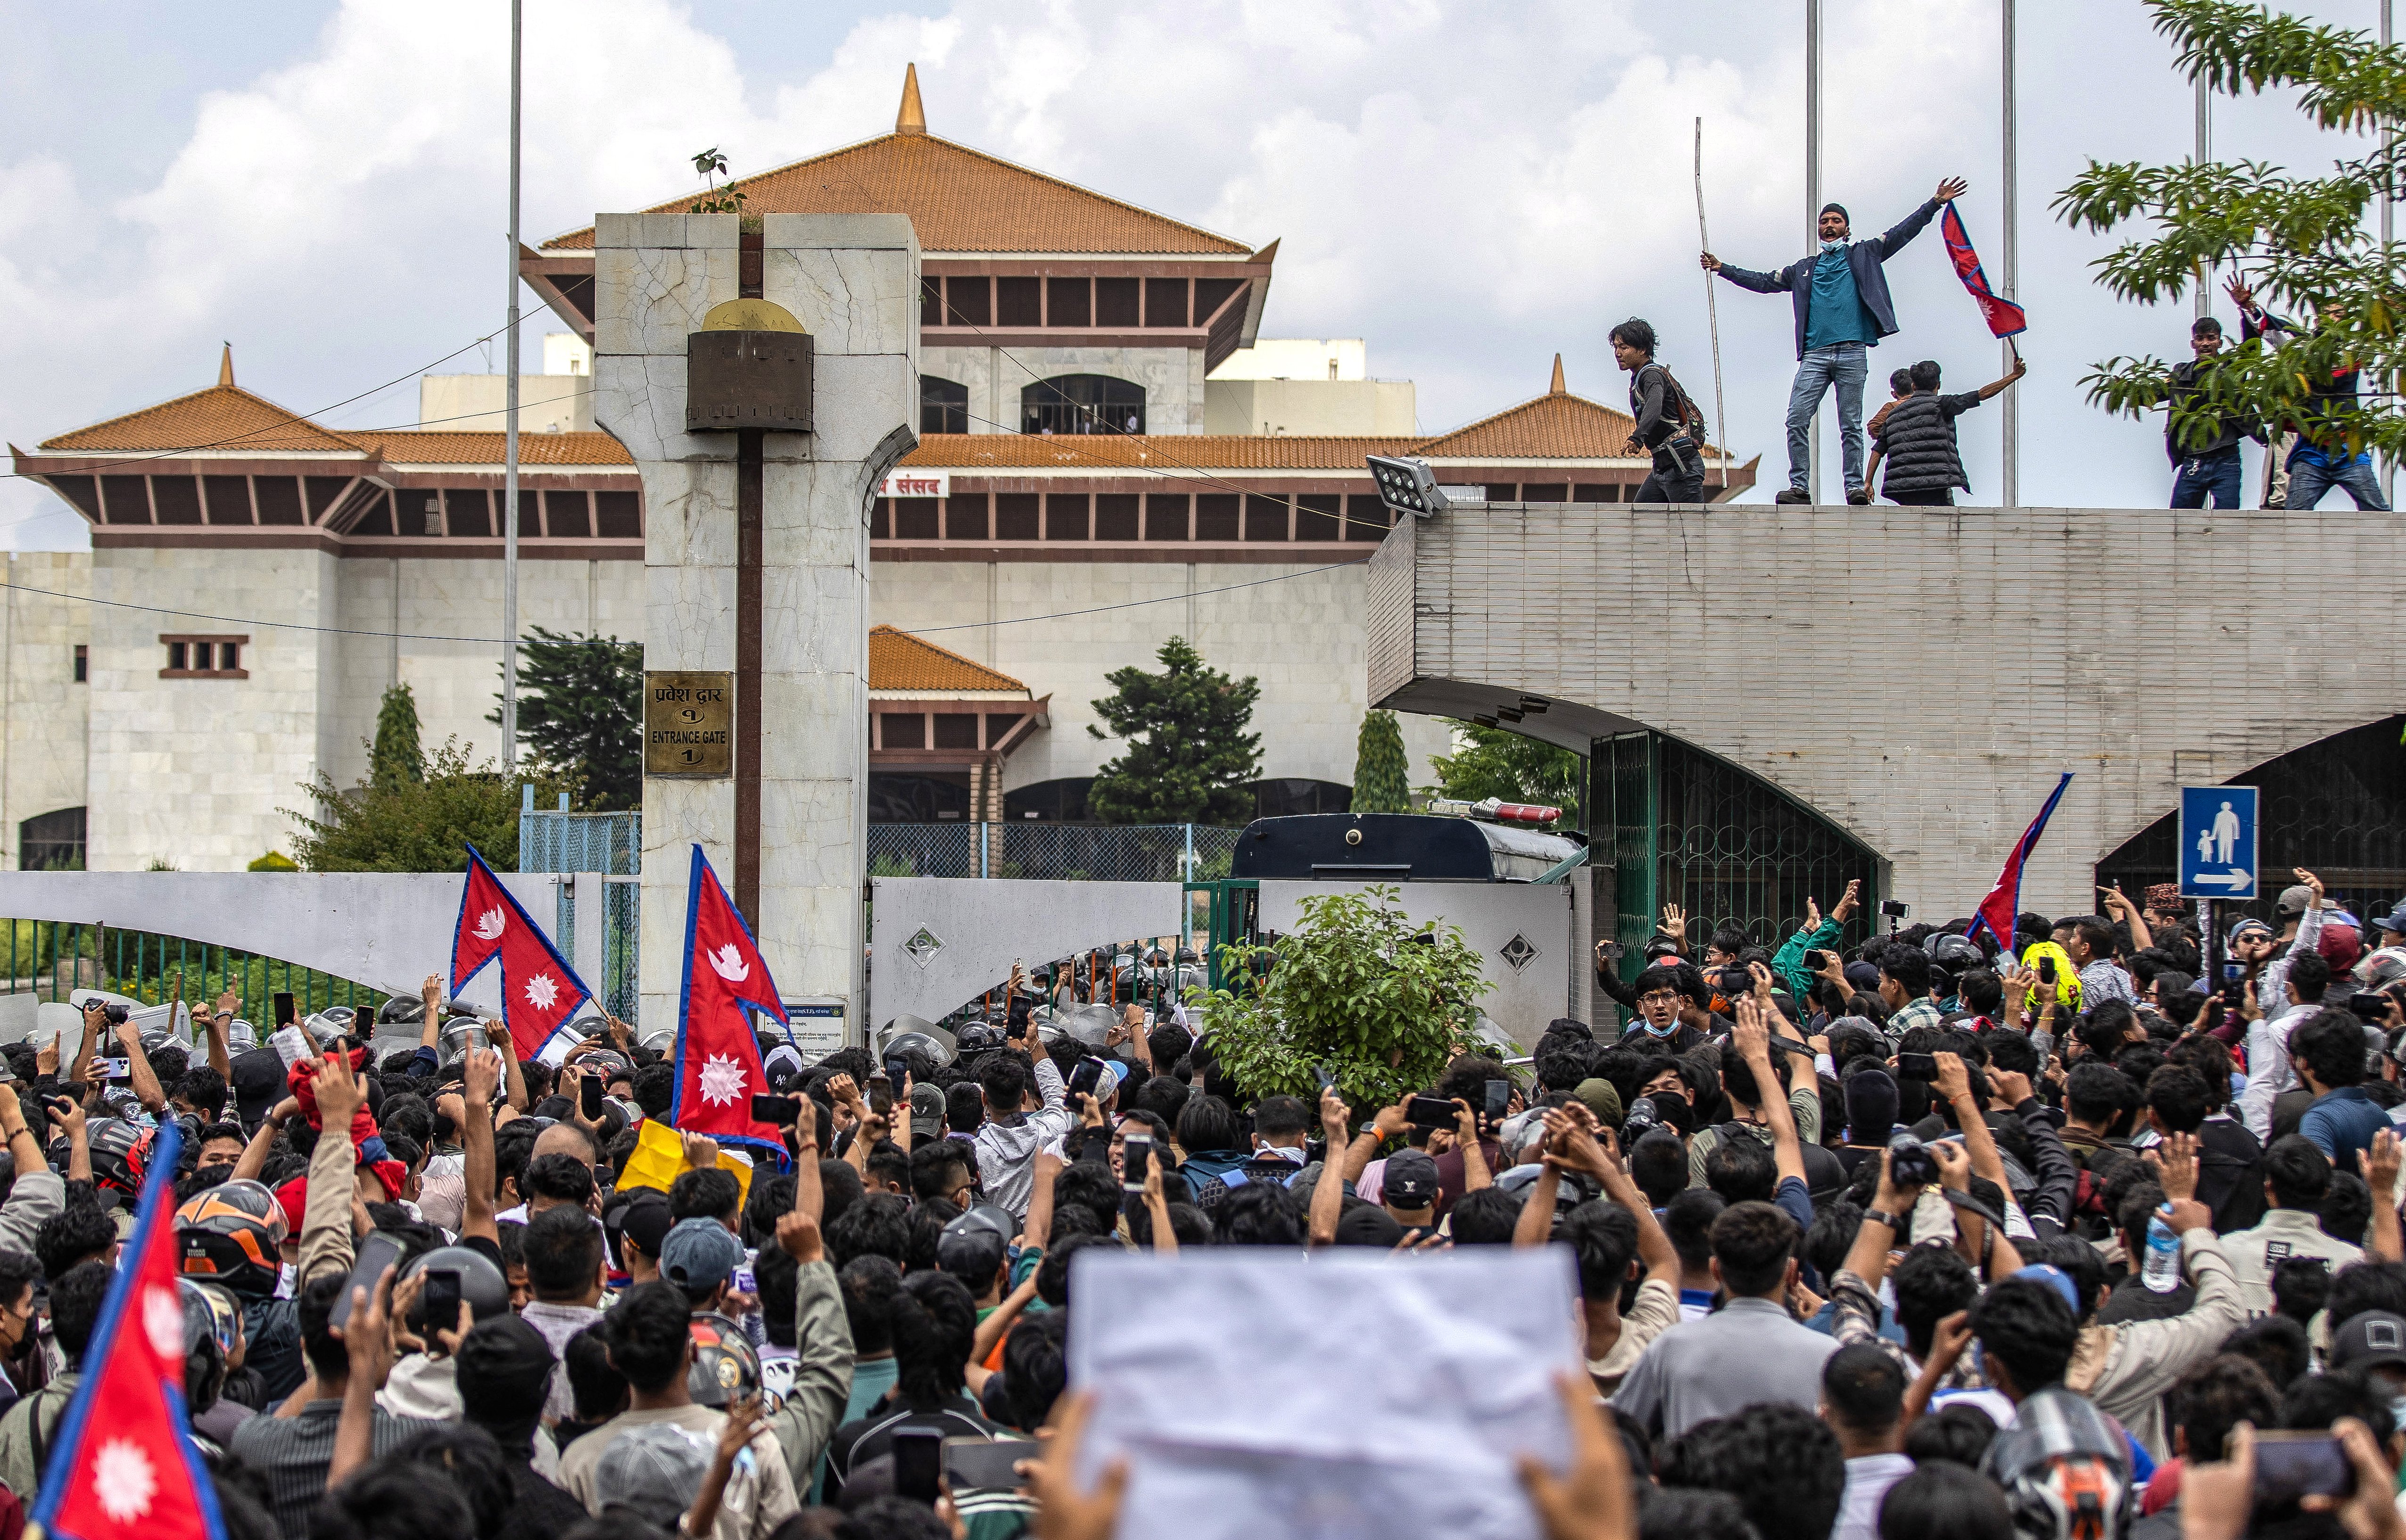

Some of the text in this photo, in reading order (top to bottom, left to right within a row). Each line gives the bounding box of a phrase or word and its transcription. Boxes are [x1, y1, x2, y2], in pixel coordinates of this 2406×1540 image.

[896, 473, 940, 494] संसद
[654, 684, 724, 704] प्रवेश द्वार
[681, 709, 696, 720] १
[652, 730, 726, 744] ENTRANCE GATE
[681, 749, 693, 762] 1
[776, 1074, 786, 1086] NY
